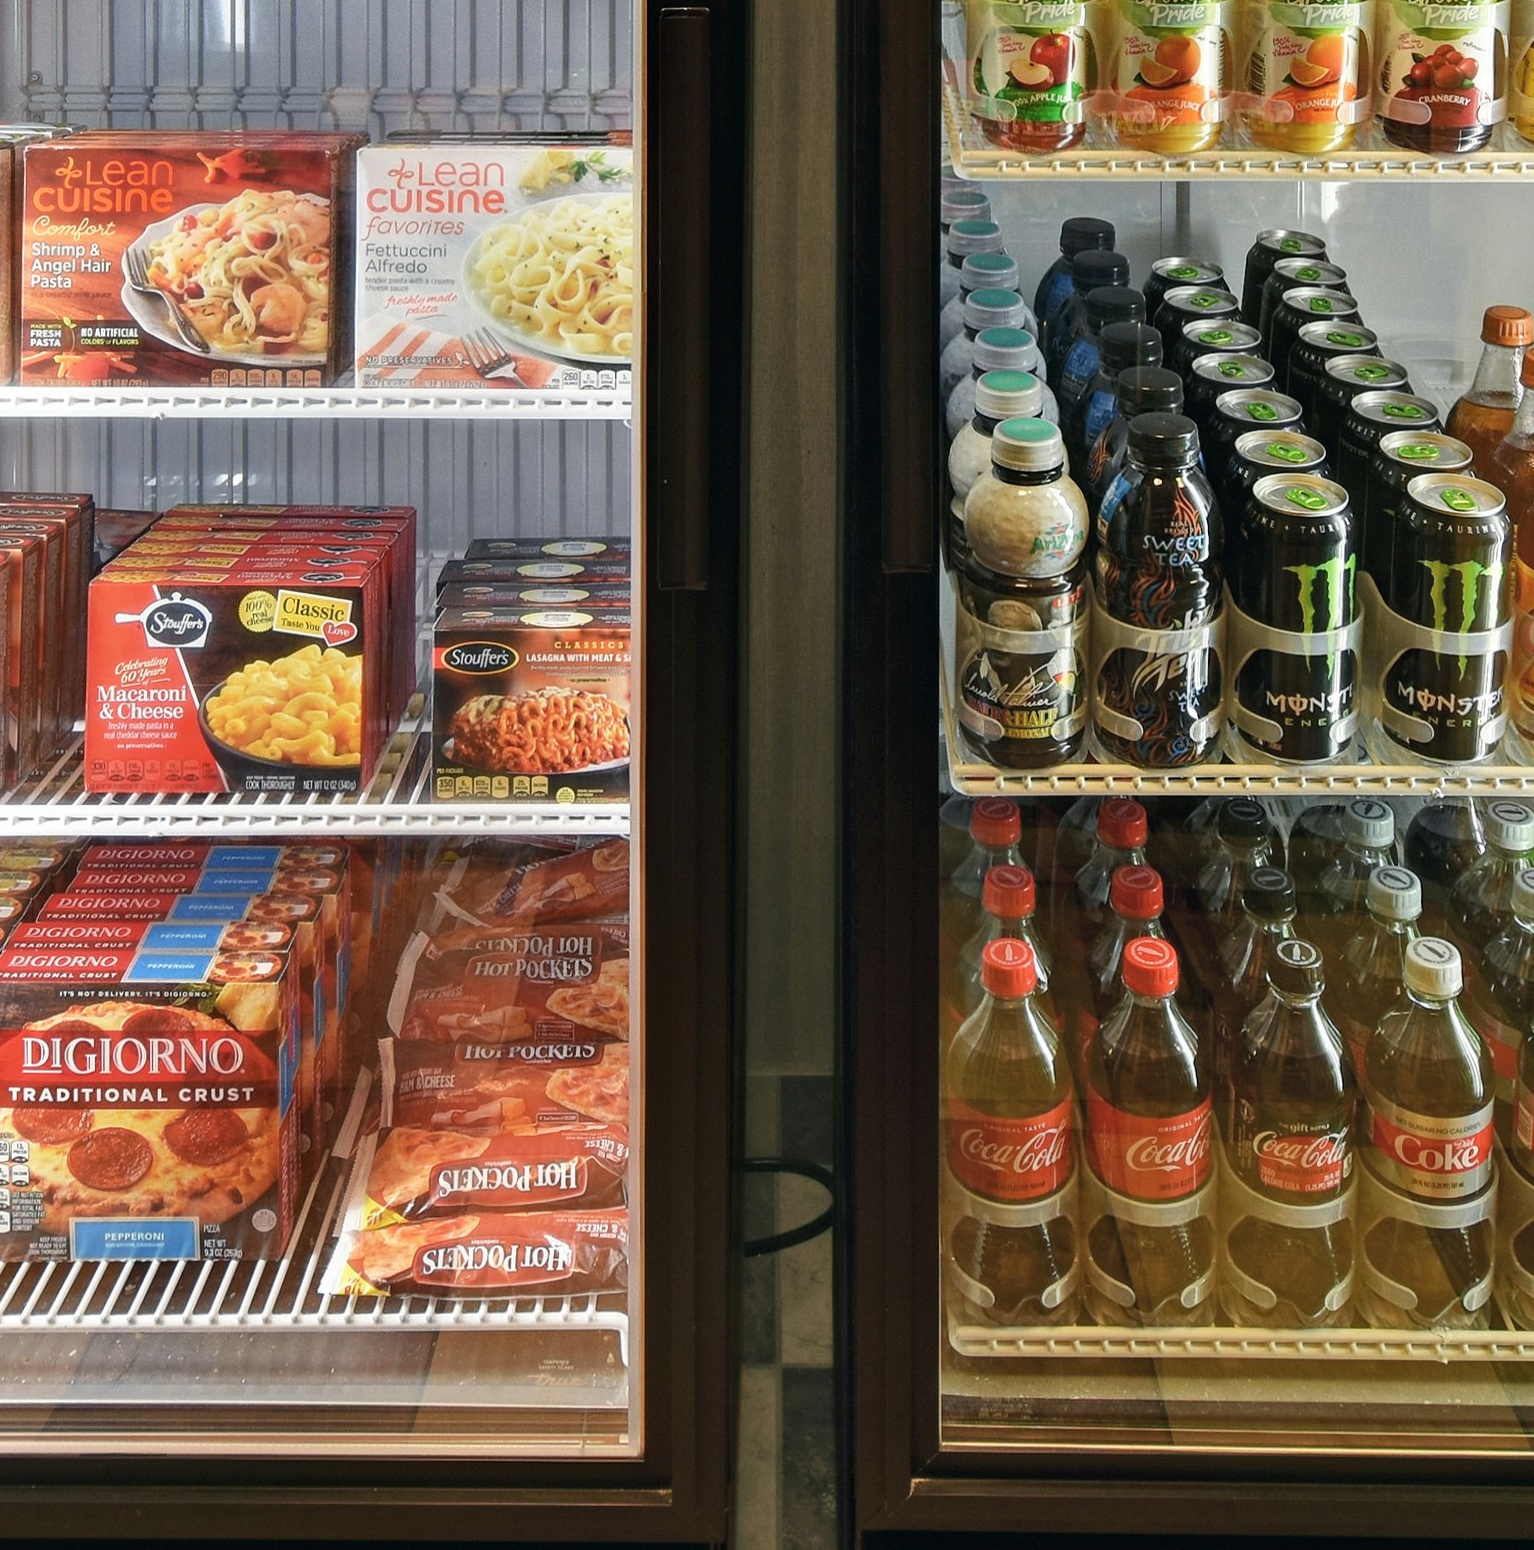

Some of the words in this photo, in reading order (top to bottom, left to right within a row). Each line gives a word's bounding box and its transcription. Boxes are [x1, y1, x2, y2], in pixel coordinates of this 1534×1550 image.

[1423, 2, 1479, 26] Pride
[1419, 94, 1471, 106] CRANBERRY
[85, 160, 172, 186] Lean
[418, 161, 505, 187] Lean
[32, 216, 115, 240] Comfort
[32, 243, 85, 258] Shrimp
[90, 244, 100, 256] &
[366, 243, 447, 258] Fettuccini
[32, 259, 76, 274] Angel
[81, 260, 111, 273] Hair
[365, 259, 427, 274] Alfredo
[32, 275, 72, 288] Pasta
[386, 296, 425, 309] freshly
[427, 293, 457, 302] made
[406, 304, 438, 315] pasta
[30, 329, 62, 338] FRESH
[81, 328, 93, 338] NO
[96, 328, 139, 338] ARTIFICIAL
[30, 338, 61, 347] PASTA
[365, 356, 385, 364] NO
[388, 356, 451, 365] PRESERVATIVES
[1437, 521, 1497, 535] TAURINE
[1143, 534, 1204, 550] SWEET
[1156, 554, 1194, 567] TEA
[244, 599, 272, 614] 100%
[283, 596, 345, 622] Classic
[246, 614, 274, 626] cheese
[251, 610, 268, 619] real
[150, 612, 204, 633] Stouffer's
[282, 618, 302, 629] Taste
[305, 621, 320, 631] You
[328, 625, 349, 637] Love
[115, 657, 168, 675] Celebrating
[450, 649, 509, 668] Stouffer's
[526, 654, 565, 663] LASAGNA
[567, 654, 590, 662] WITH
[591, 654, 613, 663] MEAT
[615, 654, 622, 662] &
[97, 686, 187, 701] Macaroni
[1398, 681, 1504, 717] MONSTER
[99, 705, 114, 719] &
[117, 704, 183, 719] Cheese
[246, 780, 260, 789] COOK
[261, 780, 295, 790] THOROUGHLY
[7, 955, 118, 967] DIGIORNO
[475, 961, 512, 976] HOT
[516, 957, 593, 980] POCKETS
[22, 1037, 245, 1074] DIGIORNO
[9, 1087, 168, 1102] TRADITIONAL
[178, 1087, 255, 1102] CRUST
[984, 1123, 1020, 1133] ORIGINAL
[1024, 1122, 1046, 1133] TASTE
[960, 1119, 1067, 1174] Coca-Cola
[1252, 1127, 1348, 1171] Coca-Cola
[1454, 1138, 1476, 1150] Diet
[1394, 1134, 1479, 1171] Coke
[438, 1164, 530, 1197] POCKETS
[535, 1159, 578, 1188] HOT
[104, 1232, 165, 1241] PEPPERONI
[204, 1225, 220, 1233] PIZZA
[422, 1245, 517, 1275] POCKETS
[521, 1247, 571, 1271] HOT
